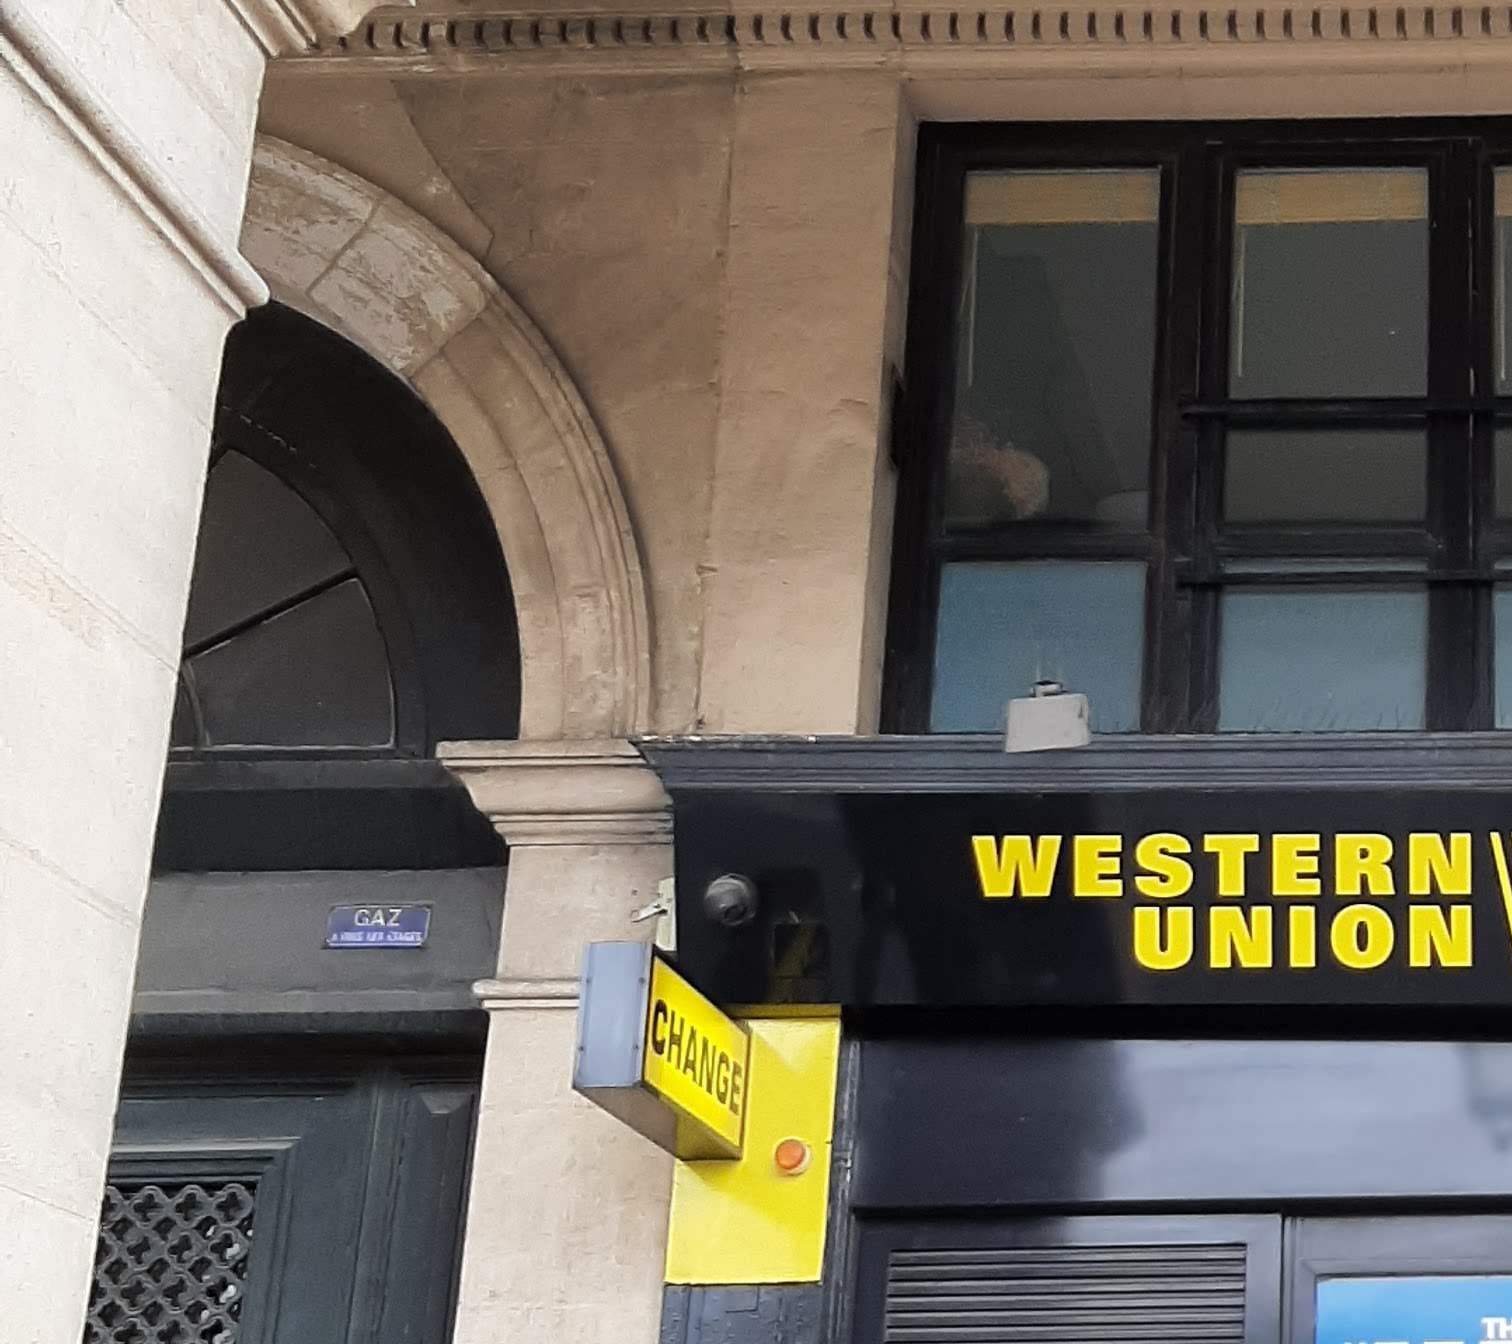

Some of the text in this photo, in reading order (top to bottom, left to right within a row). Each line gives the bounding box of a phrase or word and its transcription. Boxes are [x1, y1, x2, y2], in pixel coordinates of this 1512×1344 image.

[972, 832, 1472, 898] WESTERN
[354, 908, 402, 927] GAZ
[1133, 904, 1473, 970] UNION
[651, 999, 744, 1115] CHANGE
